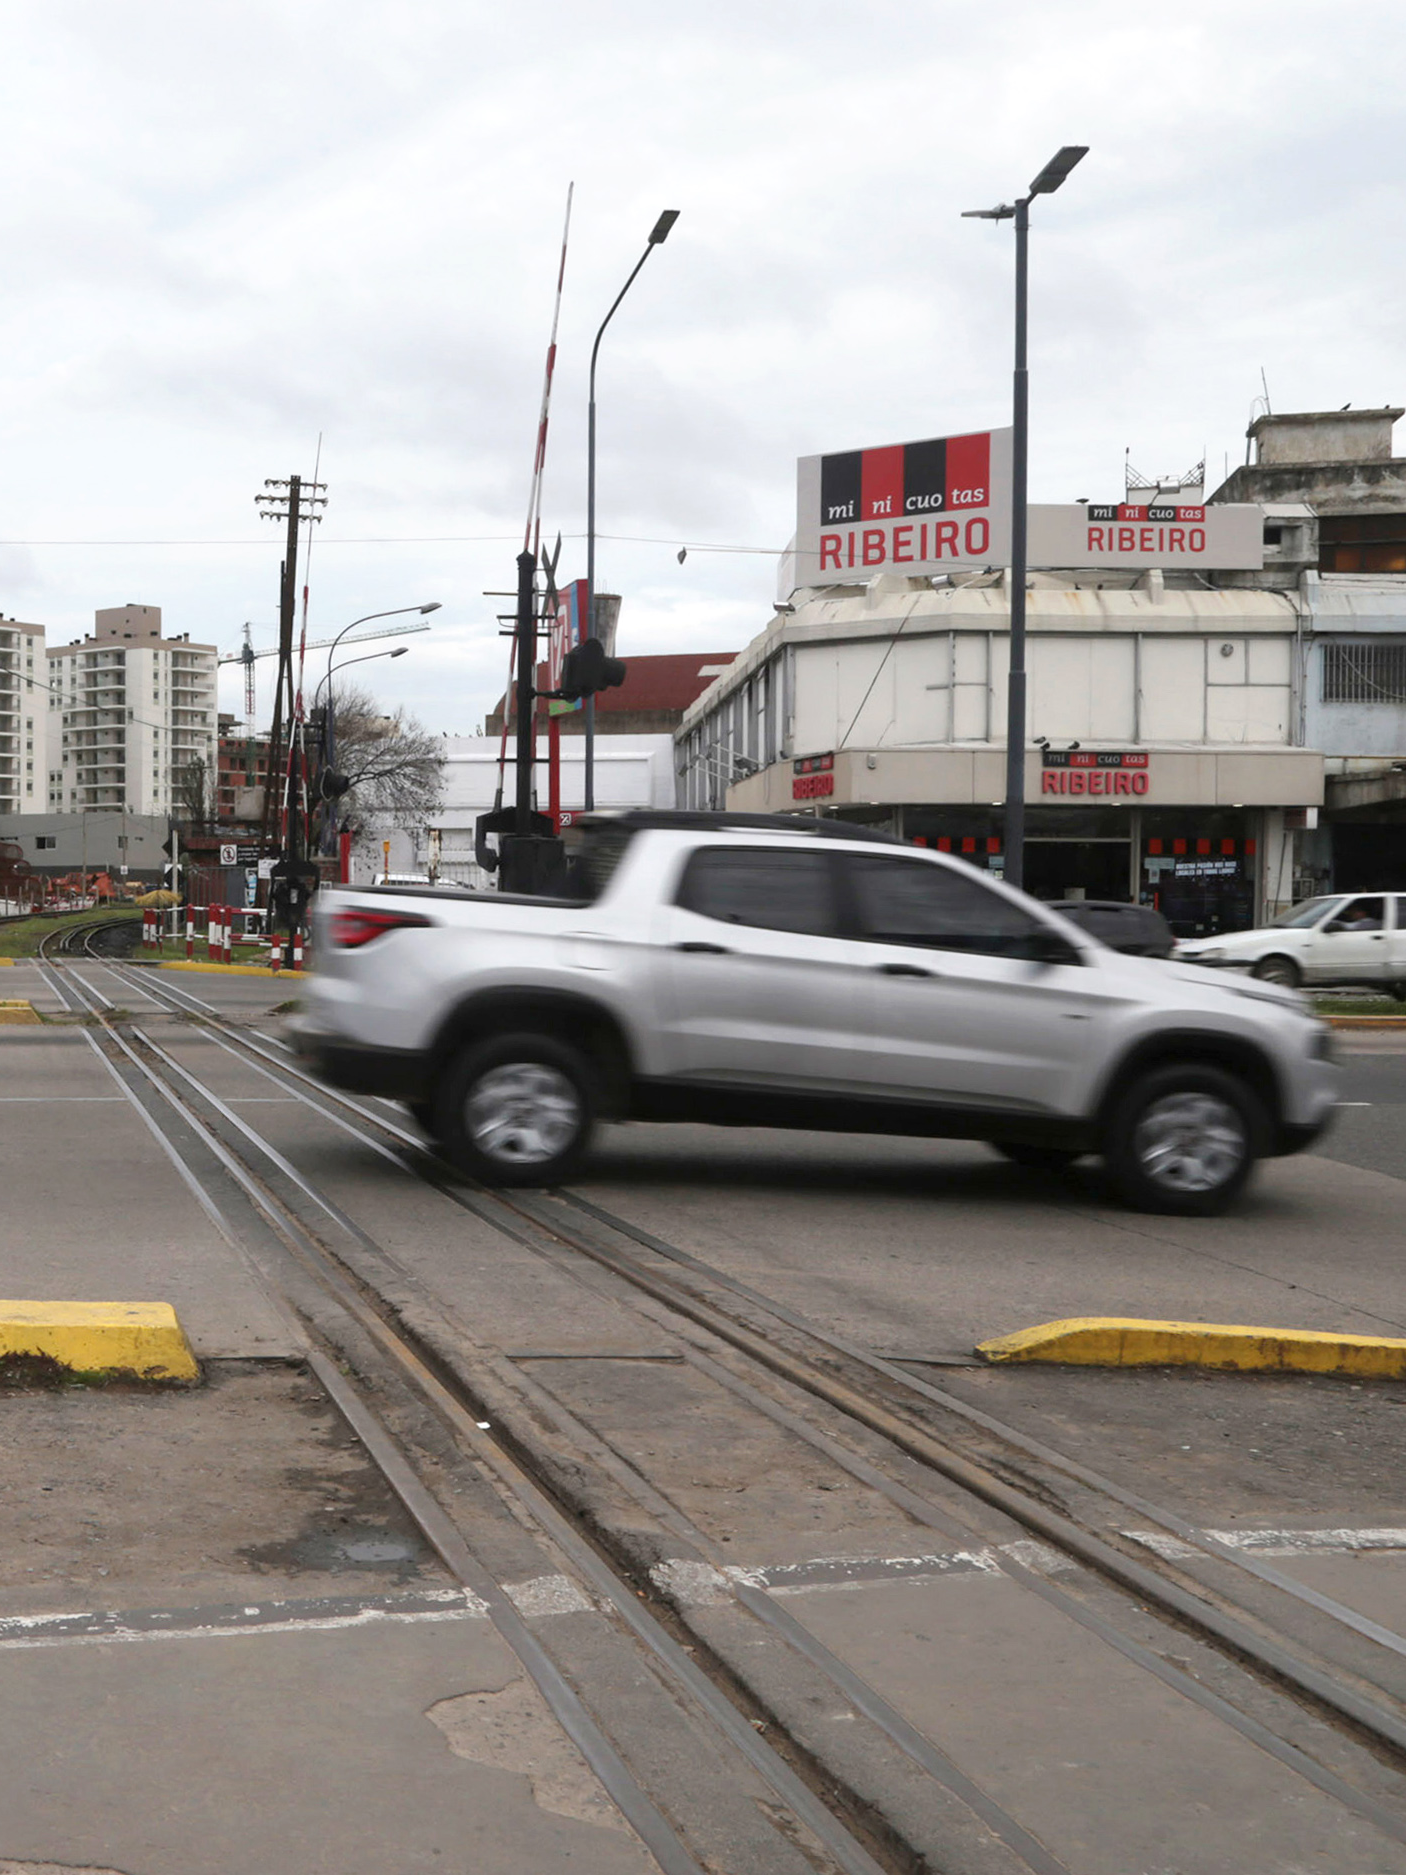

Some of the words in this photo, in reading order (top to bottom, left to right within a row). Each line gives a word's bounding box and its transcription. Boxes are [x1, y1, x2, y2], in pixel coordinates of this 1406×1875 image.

[828, 501, 854, 519] mi
[872, 495, 892, 514] ni
[906, 493, 942, 510] cuo
[951, 487, 984, 504] tas
[1094, 507, 1112, 518] mi
[1125, 507, 1139, 518] ni
[1149, 508, 1174, 518] cuo
[1180, 508, 1202, 519] tas
[820, 517, 989, 571] RIBEIRO
[1088, 527, 1205, 552] RIBEIRO
[1077, 753, 1089, 763] ni
[1097, 754, 1121, 763] cuo
[1126, 754, 1145, 763] tas
[792, 773, 834, 799] RIBEIRO
[1042, 771, 1149, 794] RIBEIRO
